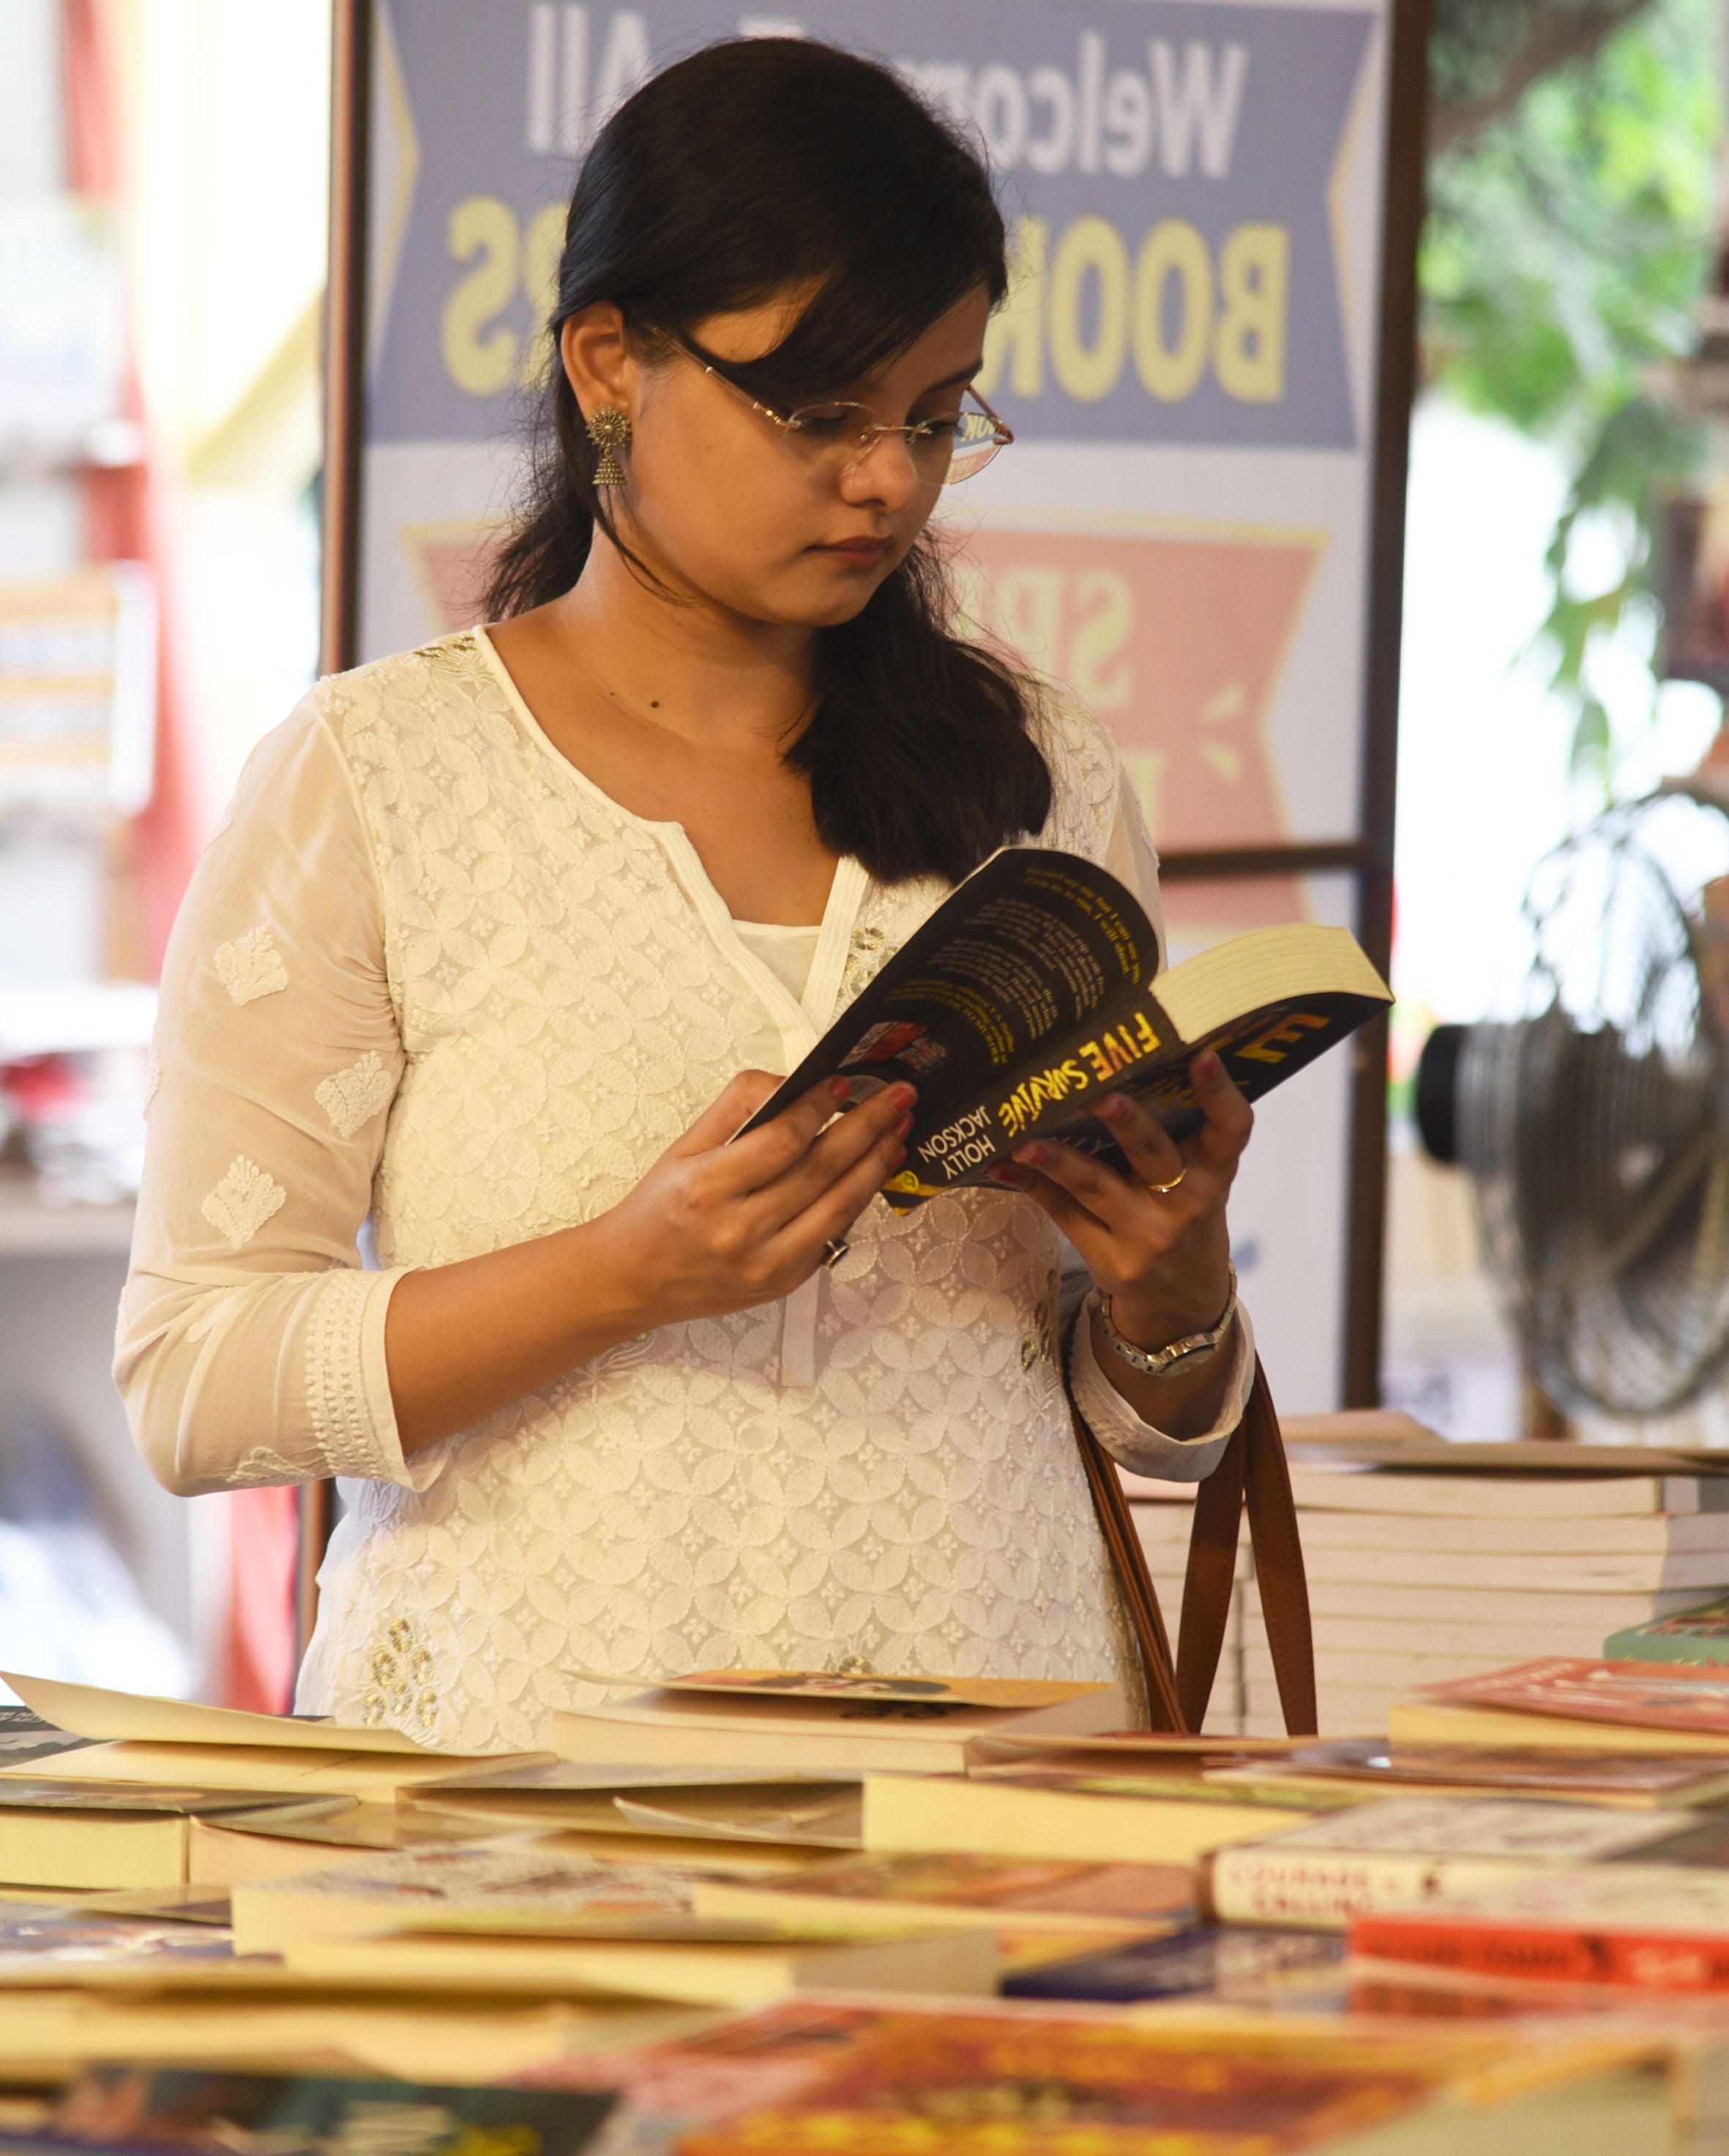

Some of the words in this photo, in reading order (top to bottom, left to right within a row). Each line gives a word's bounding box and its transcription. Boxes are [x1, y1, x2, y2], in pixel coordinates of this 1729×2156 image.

[1100, 921, 1120, 942] will
[1114, 922, 1132, 941] can
[1079, 1011, 1161, 1082] FIVE
[998, 1059, 1089, 1138] SURVIVE
[916, 1104, 992, 1163] JACKSON
[941, 1133, 996, 1180] HOLLY
